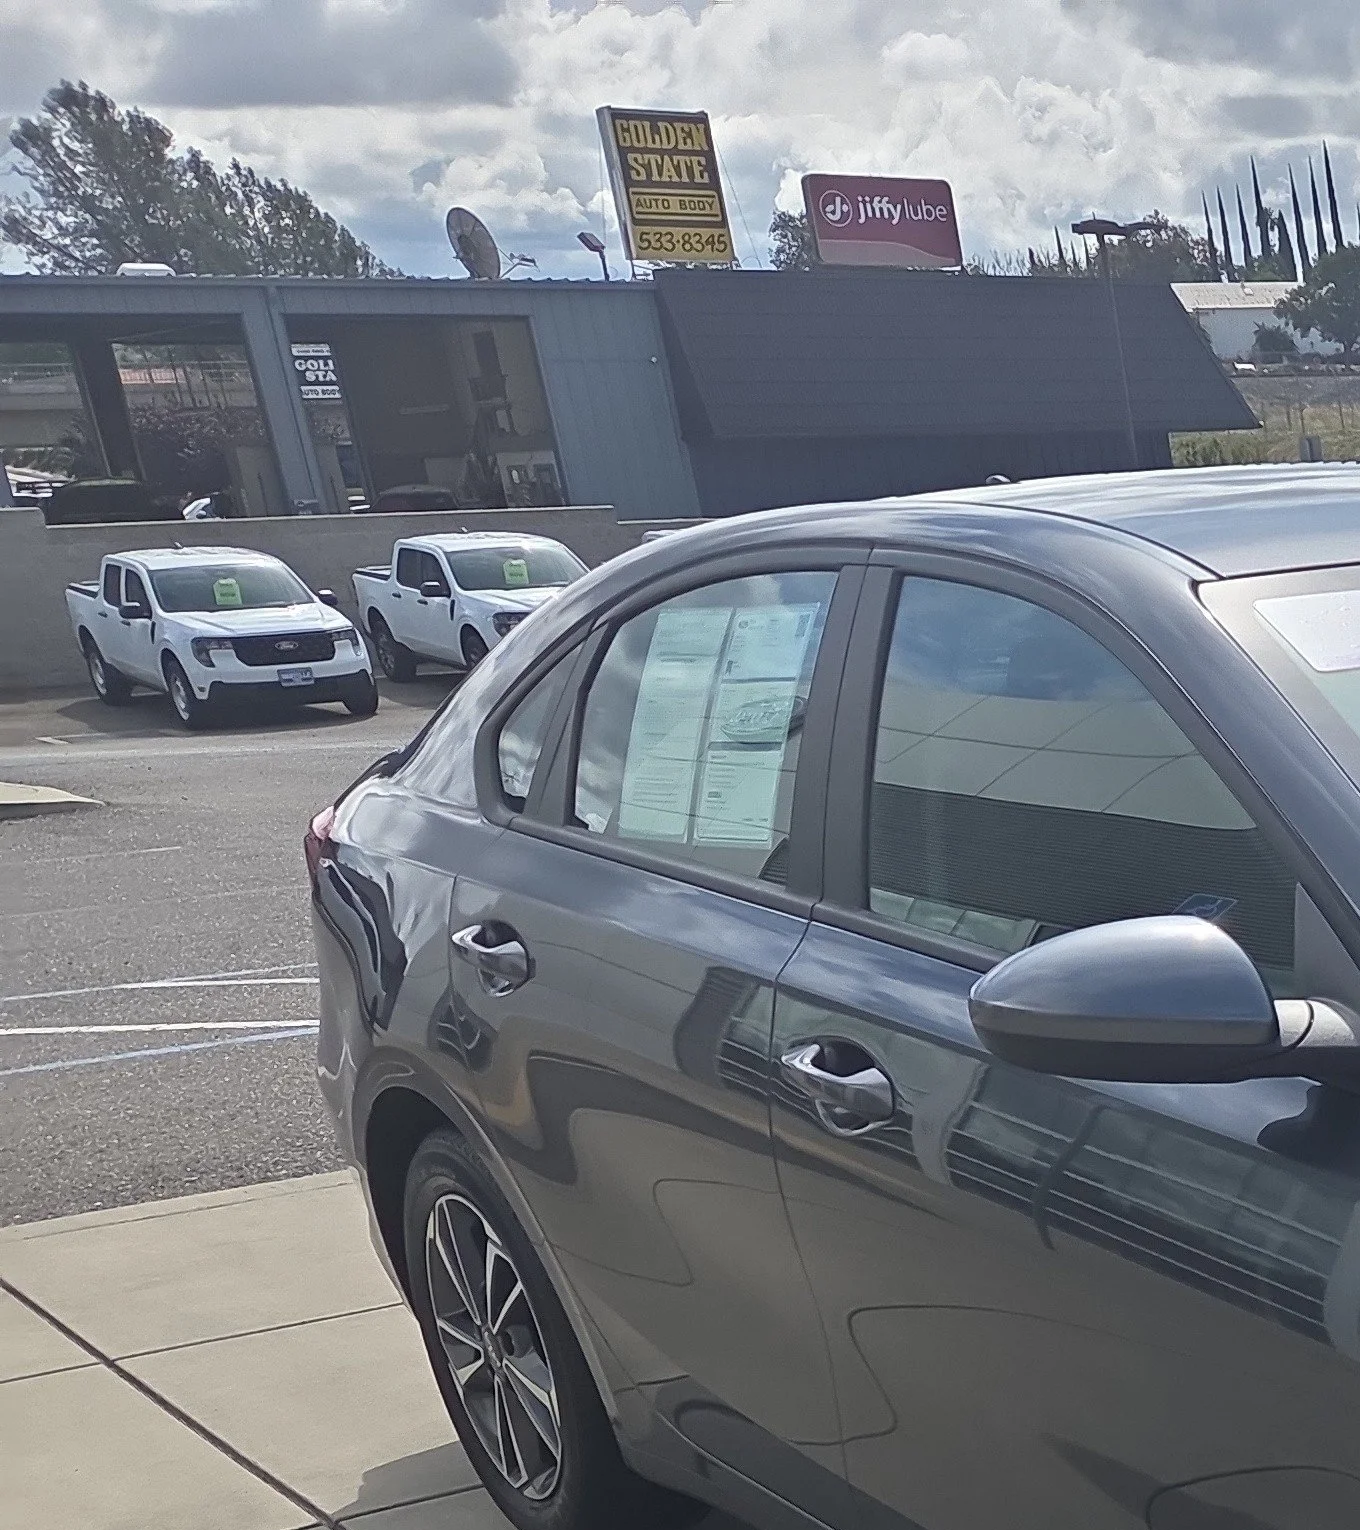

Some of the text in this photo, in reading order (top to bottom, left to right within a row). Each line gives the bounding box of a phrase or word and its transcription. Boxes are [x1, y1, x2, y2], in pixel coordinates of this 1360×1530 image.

[614, 119, 709, 151] GOLDEN
[627, 153, 709, 184] STATE
[635, 198, 715, 211] AUTO BODY
